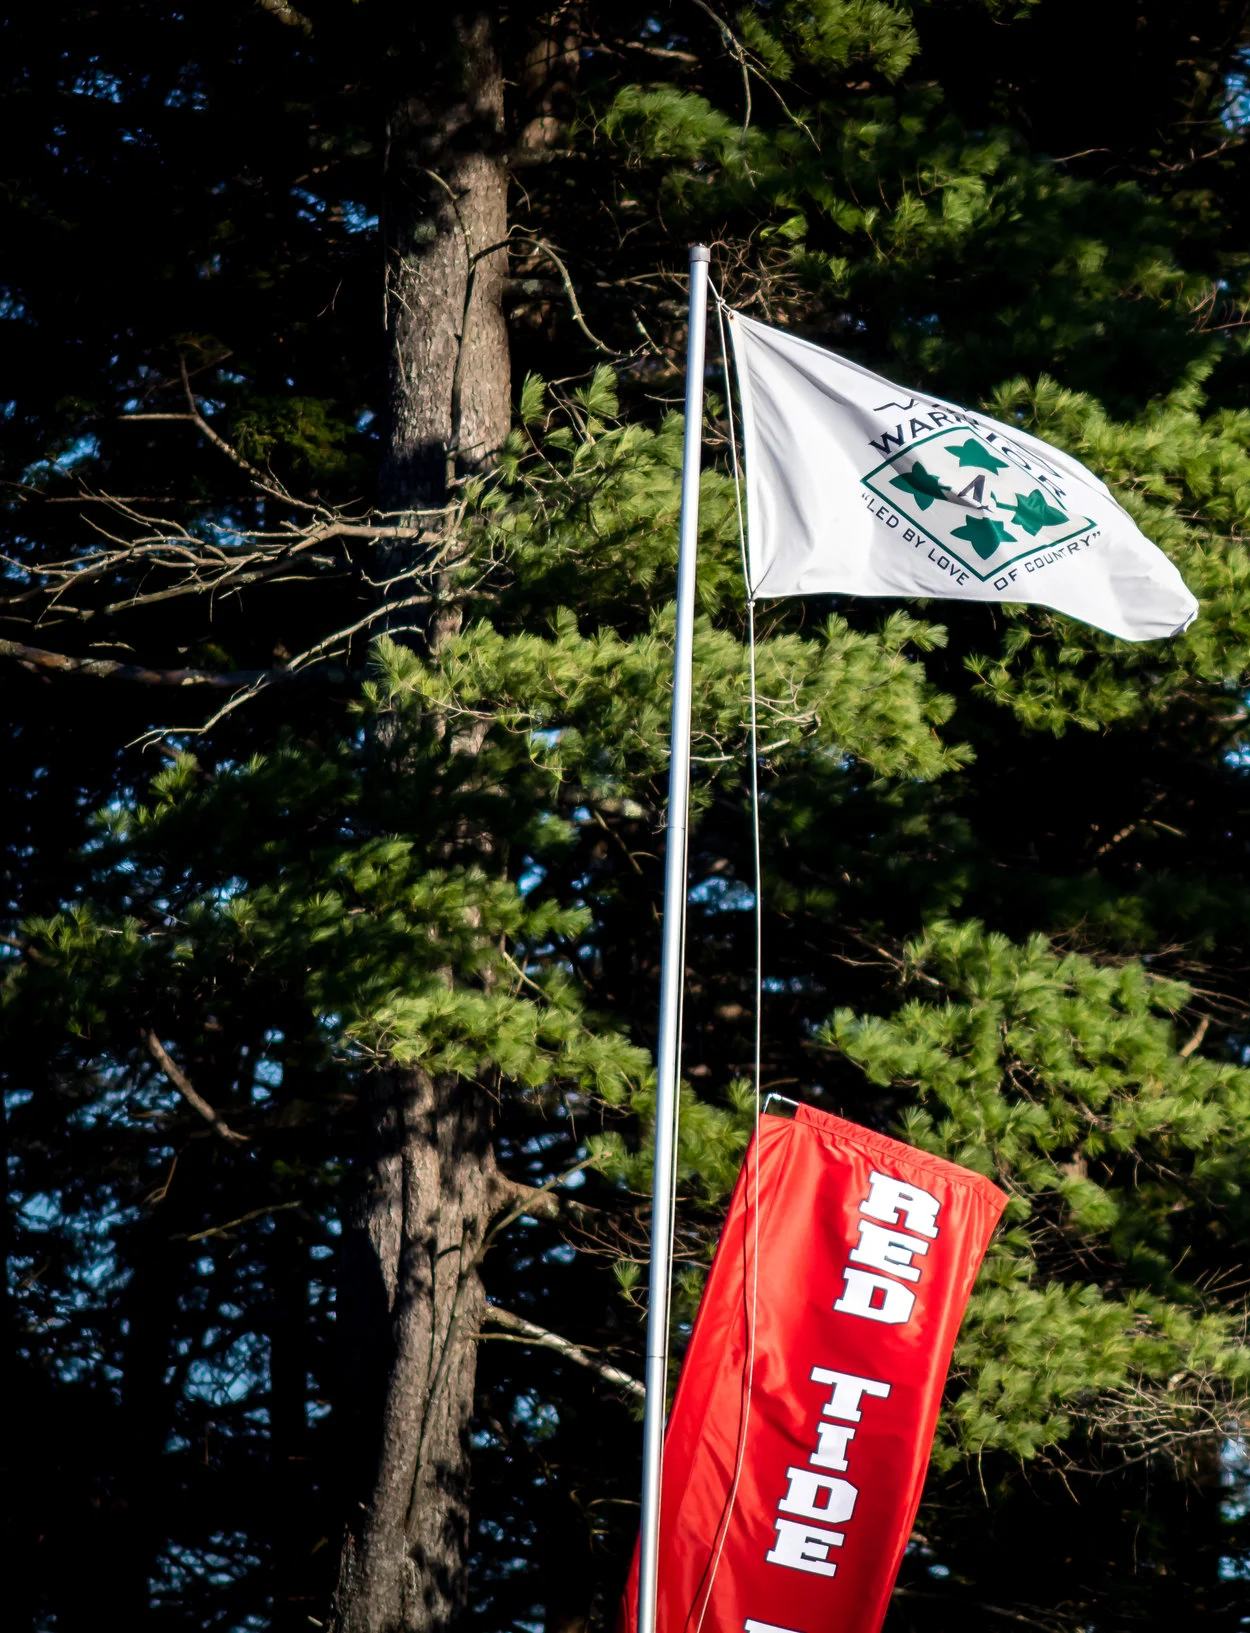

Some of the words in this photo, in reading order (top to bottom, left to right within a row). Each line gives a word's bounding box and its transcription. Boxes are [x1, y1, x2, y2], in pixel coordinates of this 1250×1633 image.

[902, 527, 926, 549] BY
[928, 548, 970, 586] LOVE
[993, 568, 1019, 591] OF
[833, 1170, 942, 1325] RED
[765, 1365, 892, 1578] TIDE
